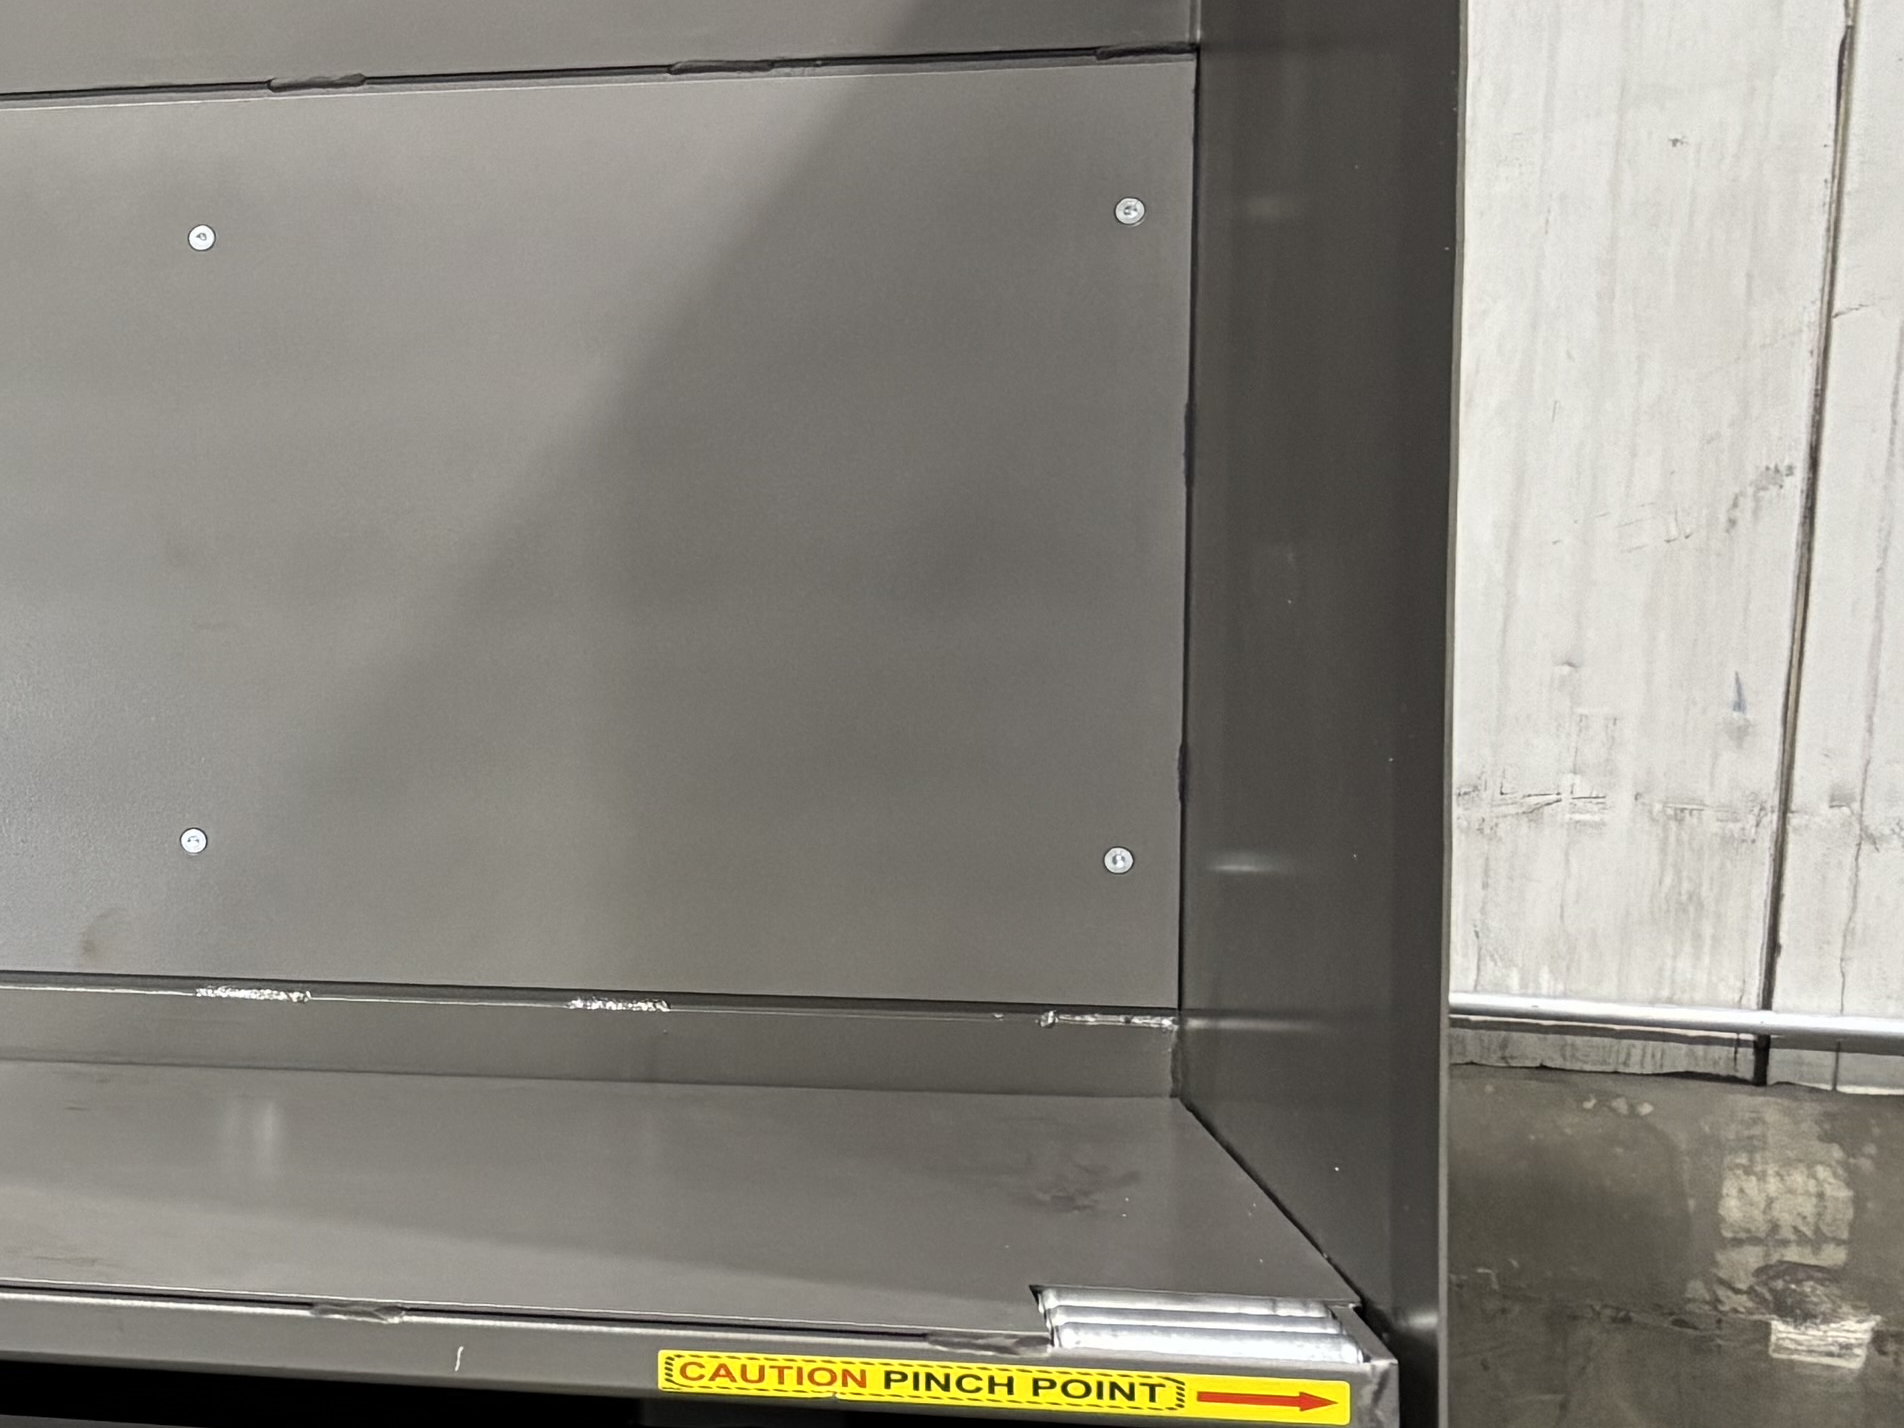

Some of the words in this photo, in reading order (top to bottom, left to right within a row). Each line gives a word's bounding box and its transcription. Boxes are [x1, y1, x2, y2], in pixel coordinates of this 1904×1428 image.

[678, 1360, 869, 1390] CAUTION
[883, 1369, 1016, 1398] PINCH
[1031, 1375, 1167, 1405] POINT
